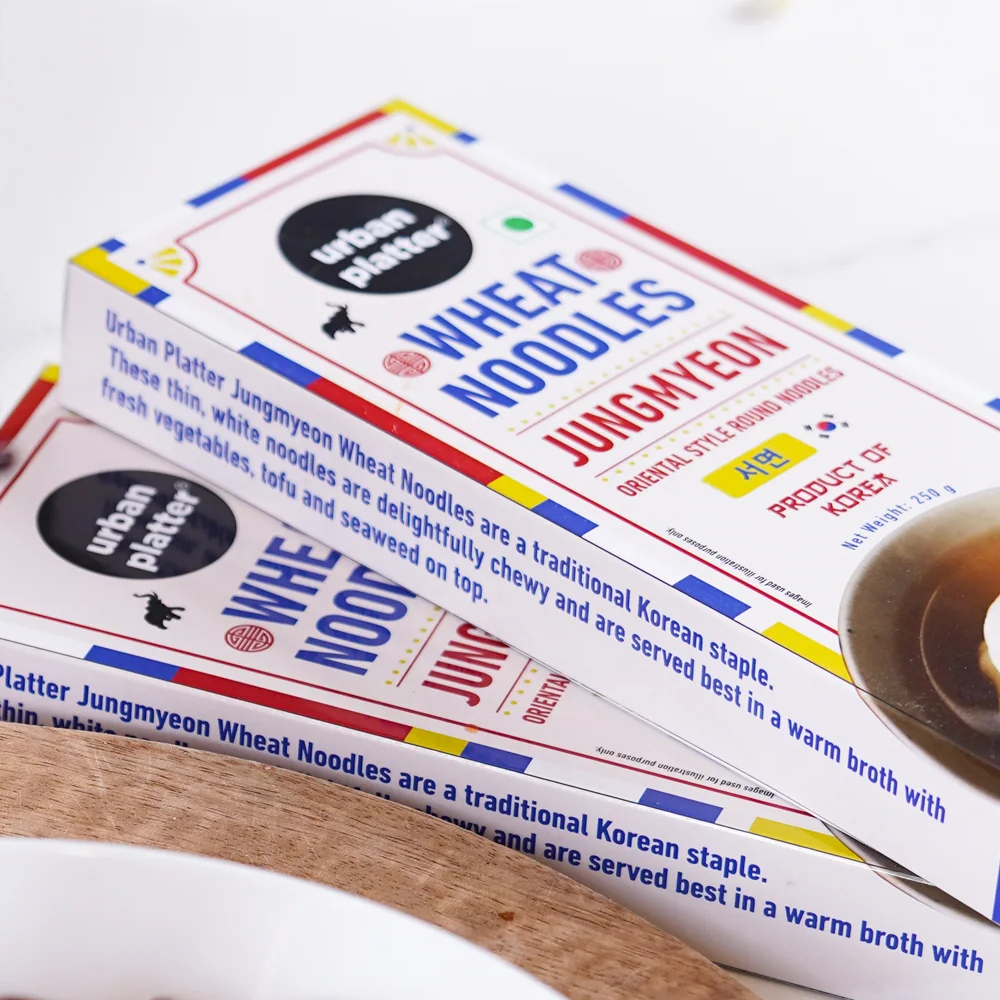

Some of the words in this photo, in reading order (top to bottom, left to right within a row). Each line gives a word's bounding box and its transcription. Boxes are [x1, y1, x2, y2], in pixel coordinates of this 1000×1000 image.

[310, 208, 418, 265] urban
[397, 253, 599, 361] WHEAT
[438, 279, 695, 418] NOODLES
[542, 325, 790, 467] JUNGMYEON
[616, 452, 694, 497] ORIENTAL
[683, 423, 736, 457] STYLE
[734, 399, 783, 433] ROUND
[774, 366, 845, 405] NOODLES
[101, 376, 148, 419] fresh
[153, 407, 255, 478] vegetables,
[260, 463, 297, 500] tofu
[302, 488, 335, 519] and
[340, 510, 420, 566] seaweed
[426, 556, 447, 581] on
[453, 567, 489, 604] top.
[734, 448, 790, 480] 서면
[766, 459, 865, 518] PRODUCT
[859, 442, 892, 464] OF
[820, 472, 898, 517] KOREA
[86, 483, 158, 556] urban
[105, 309, 158, 355] Urban
[163, 339, 226, 391] Platter
[230, 378, 333, 452] Jungmyeon
[338, 434, 395, 485] Wheat
[400, 468, 476, 528] Noodles
[480, 517, 510, 546] are
[515, 536, 526, 555] a
[532, 540, 632, 613] traditional
[637, 595, 704, 652] Korean
[709, 640, 774, 691] staple.
[841, 532, 868, 551] Net
[860, 501, 913, 533] Weight:
[910, 487, 941, 505] 250
[944, 484, 957, 494] g
[682, 536, 718, 557] purposes
[716, 554, 756, 579] illustration
[108, 345, 161, 391] These
[167, 377, 206, 417] thin,
[211, 403, 260, 445] white
[265, 435, 337, 487] noodles
[341, 477, 371, 505] are
[376, 493, 486, 570] delightfully
[490, 556, 551, 606] chewy
[555, 591, 590, 624] and
[595, 612, 626, 643] are
[631, 632, 696, 681] served
[700, 664, 742, 708] best
[747, 690, 765, 720] in
[770, 709, 781, 729] a
[787, 718, 842, 763] warm
[847, 746, 899, 796] broth
[904, 784, 946, 824] with
[221, 534, 342, 626] WHE
[754, 575, 768, 585] for
[766, 580, 786, 593] used
[784, 589, 813, 608] Images
[76, 684, 210, 737] Jungmyeon
[217, 718, 291, 759] Wheat
[297, 739, 392, 784] Noodles
[398, 771, 437, 795] are
[443, 783, 457, 801] a
[464, 785, 589, 837] traditional
[596, 818, 680, 860] Korean
[686, 846, 768, 884] staple.
[617, 752, 658, 768] purposes
[658, 763, 705, 781] illustration
[705, 776, 721, 785] for
[720, 778, 742, 789] used
[743, 785, 775, 799] Images
[493, 829, 537, 855] and
[543, 841, 582, 866] are
[588, 854, 669, 890] served
[676, 871, 727, 906] best
[733, 887, 757, 913] in
[763, 899, 777, 919] a
[784, 905, 852, 939] warm
[859, 920, 924, 958] broth
[932, 943, 984, 975] with
